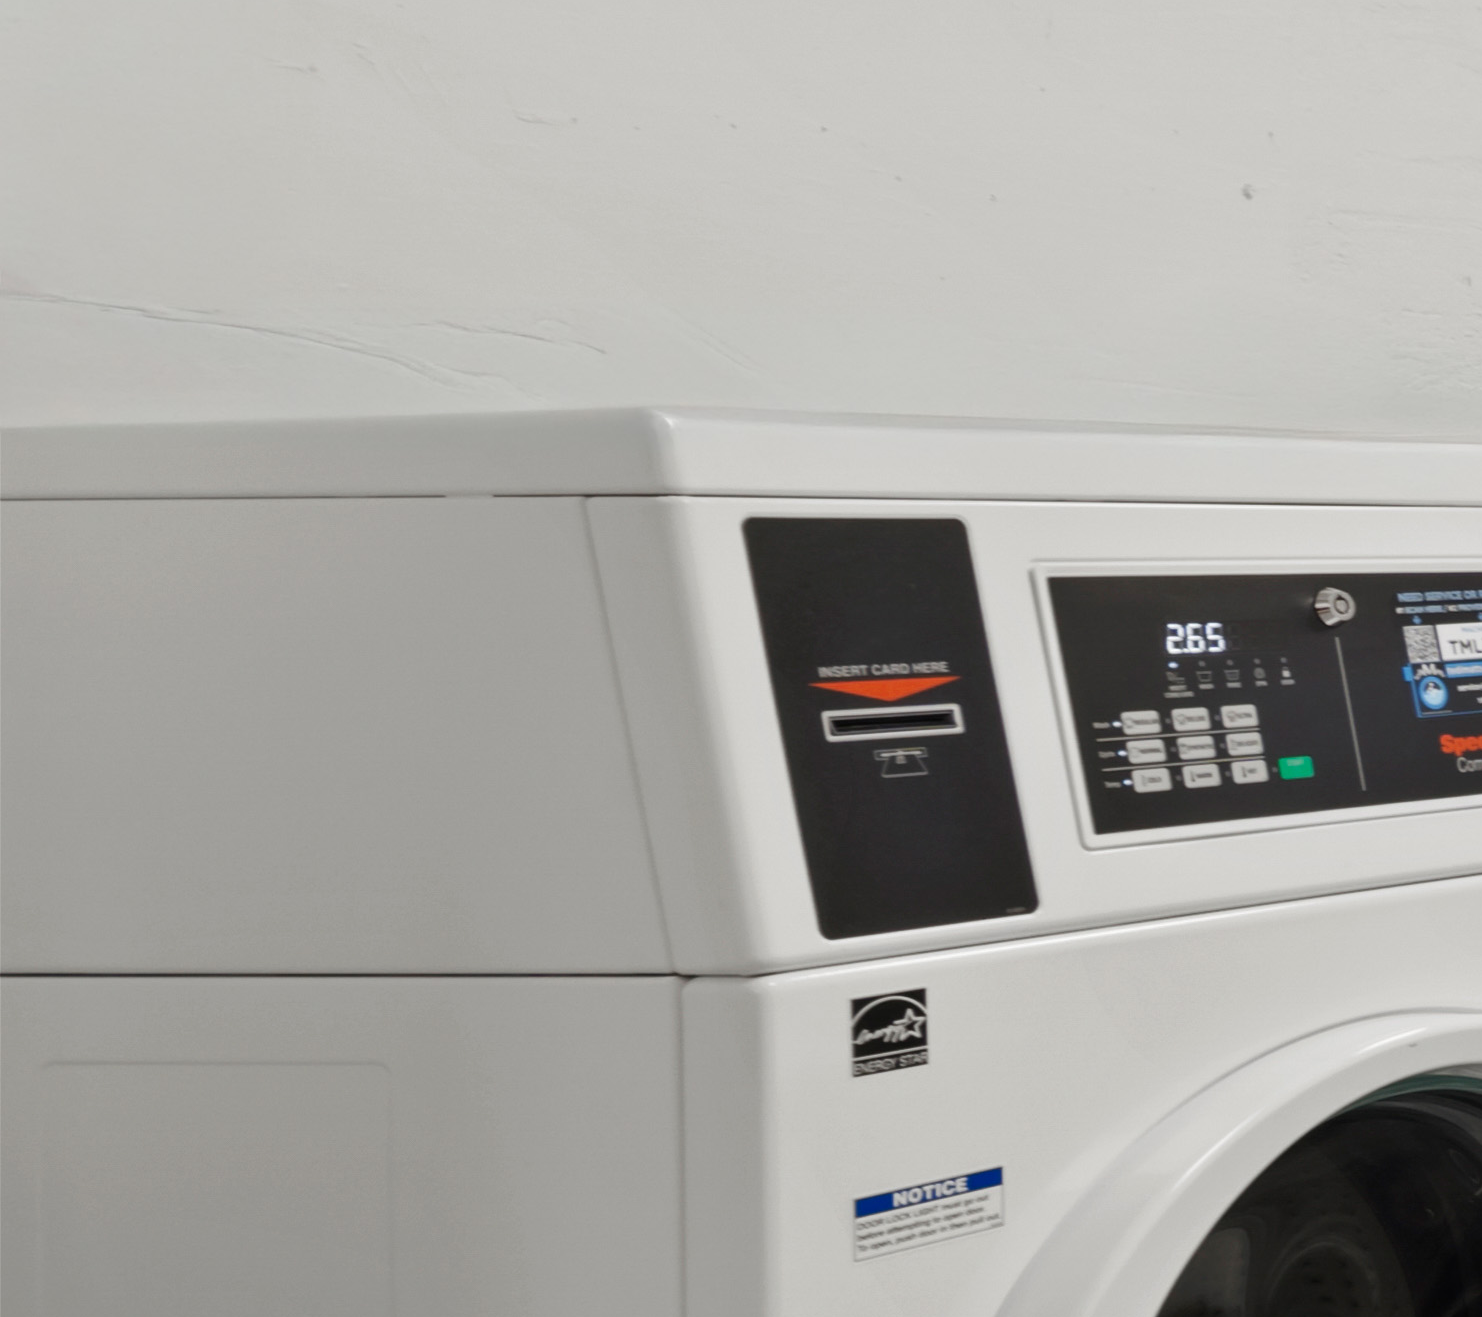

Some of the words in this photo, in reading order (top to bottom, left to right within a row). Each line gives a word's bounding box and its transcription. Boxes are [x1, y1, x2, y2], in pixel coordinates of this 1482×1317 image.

[817, 665, 868, 678] INSERT
[870, 663, 911, 676] CARD
[912, 661, 950, 674] HERE
[853, 1058, 897, 1075] ENERGY
[893, 1177, 969, 1207] NOTICE
